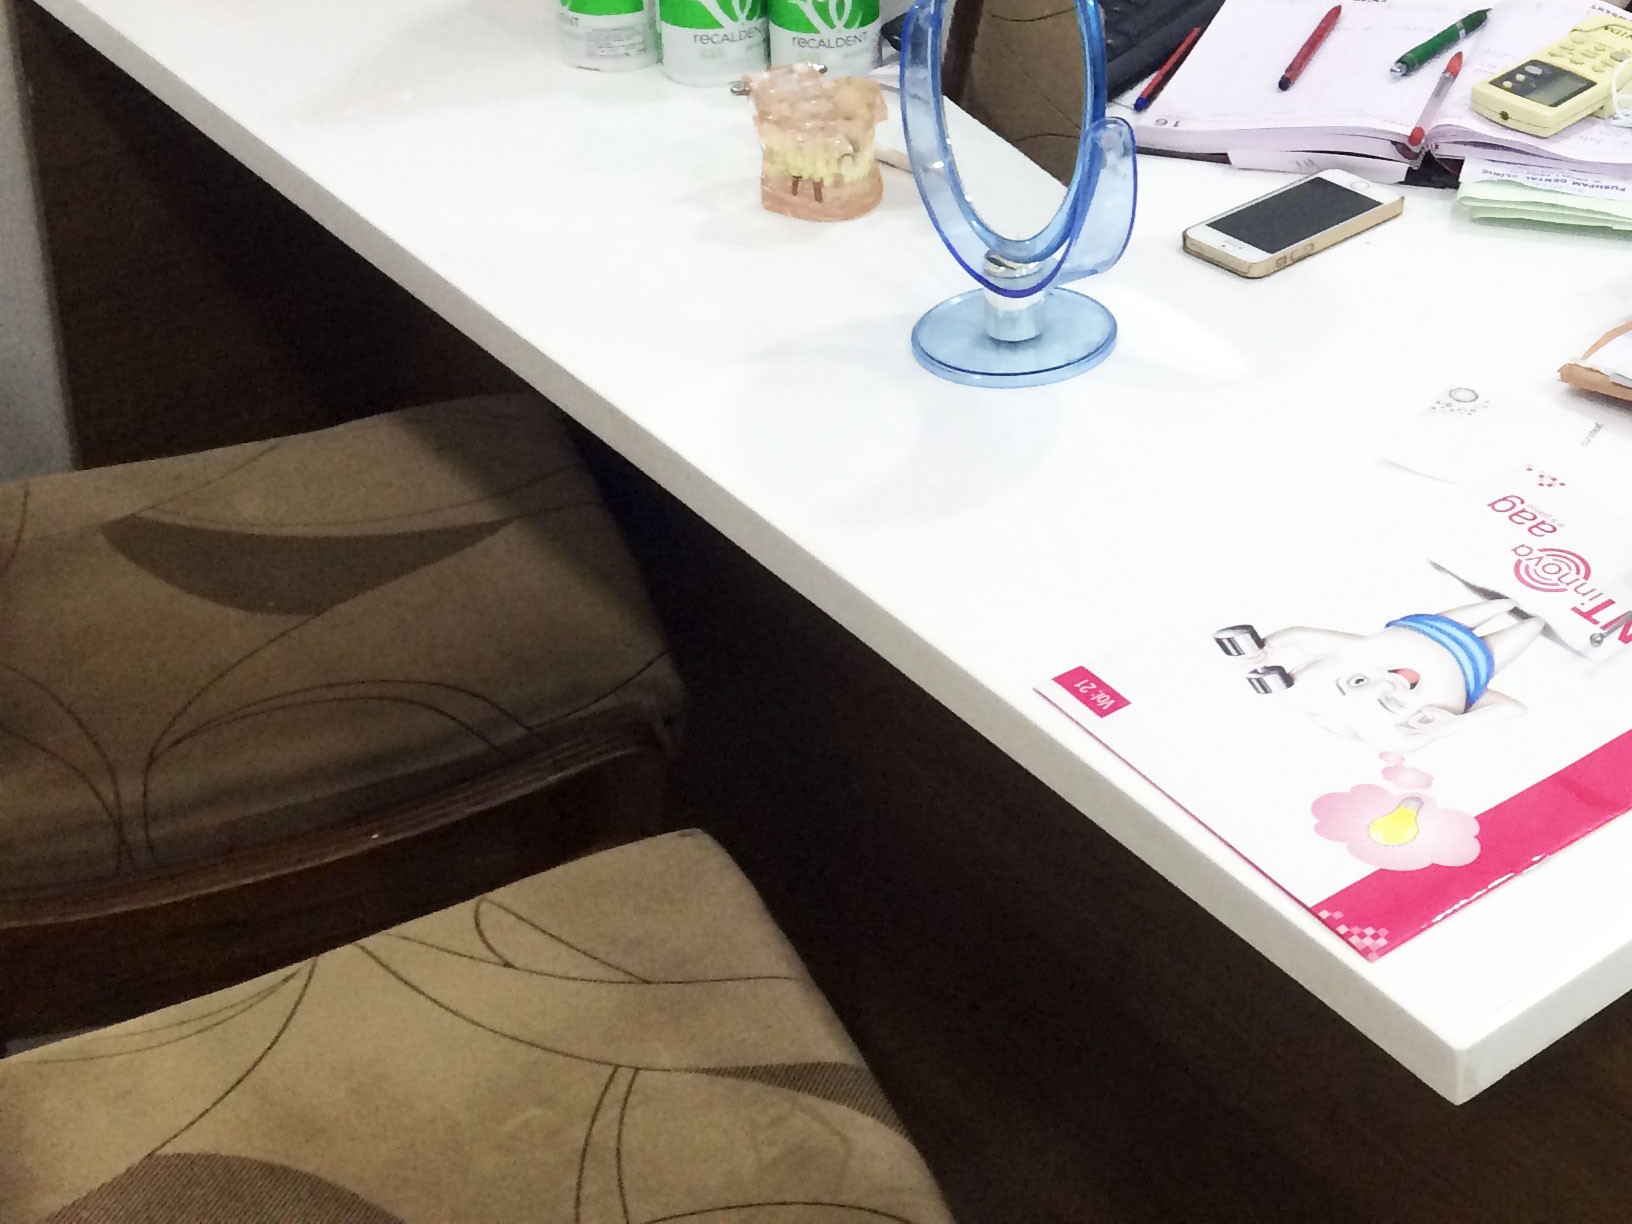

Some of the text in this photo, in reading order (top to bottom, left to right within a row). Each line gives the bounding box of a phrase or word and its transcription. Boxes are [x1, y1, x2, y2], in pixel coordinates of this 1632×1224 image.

[1154, 117, 1182, 128] 16
[1525, 175, 1568, 185] DENTAL
[1571, 180, 1627, 193] PUSHPAM
[1073, 678, 1098, 694] 21
